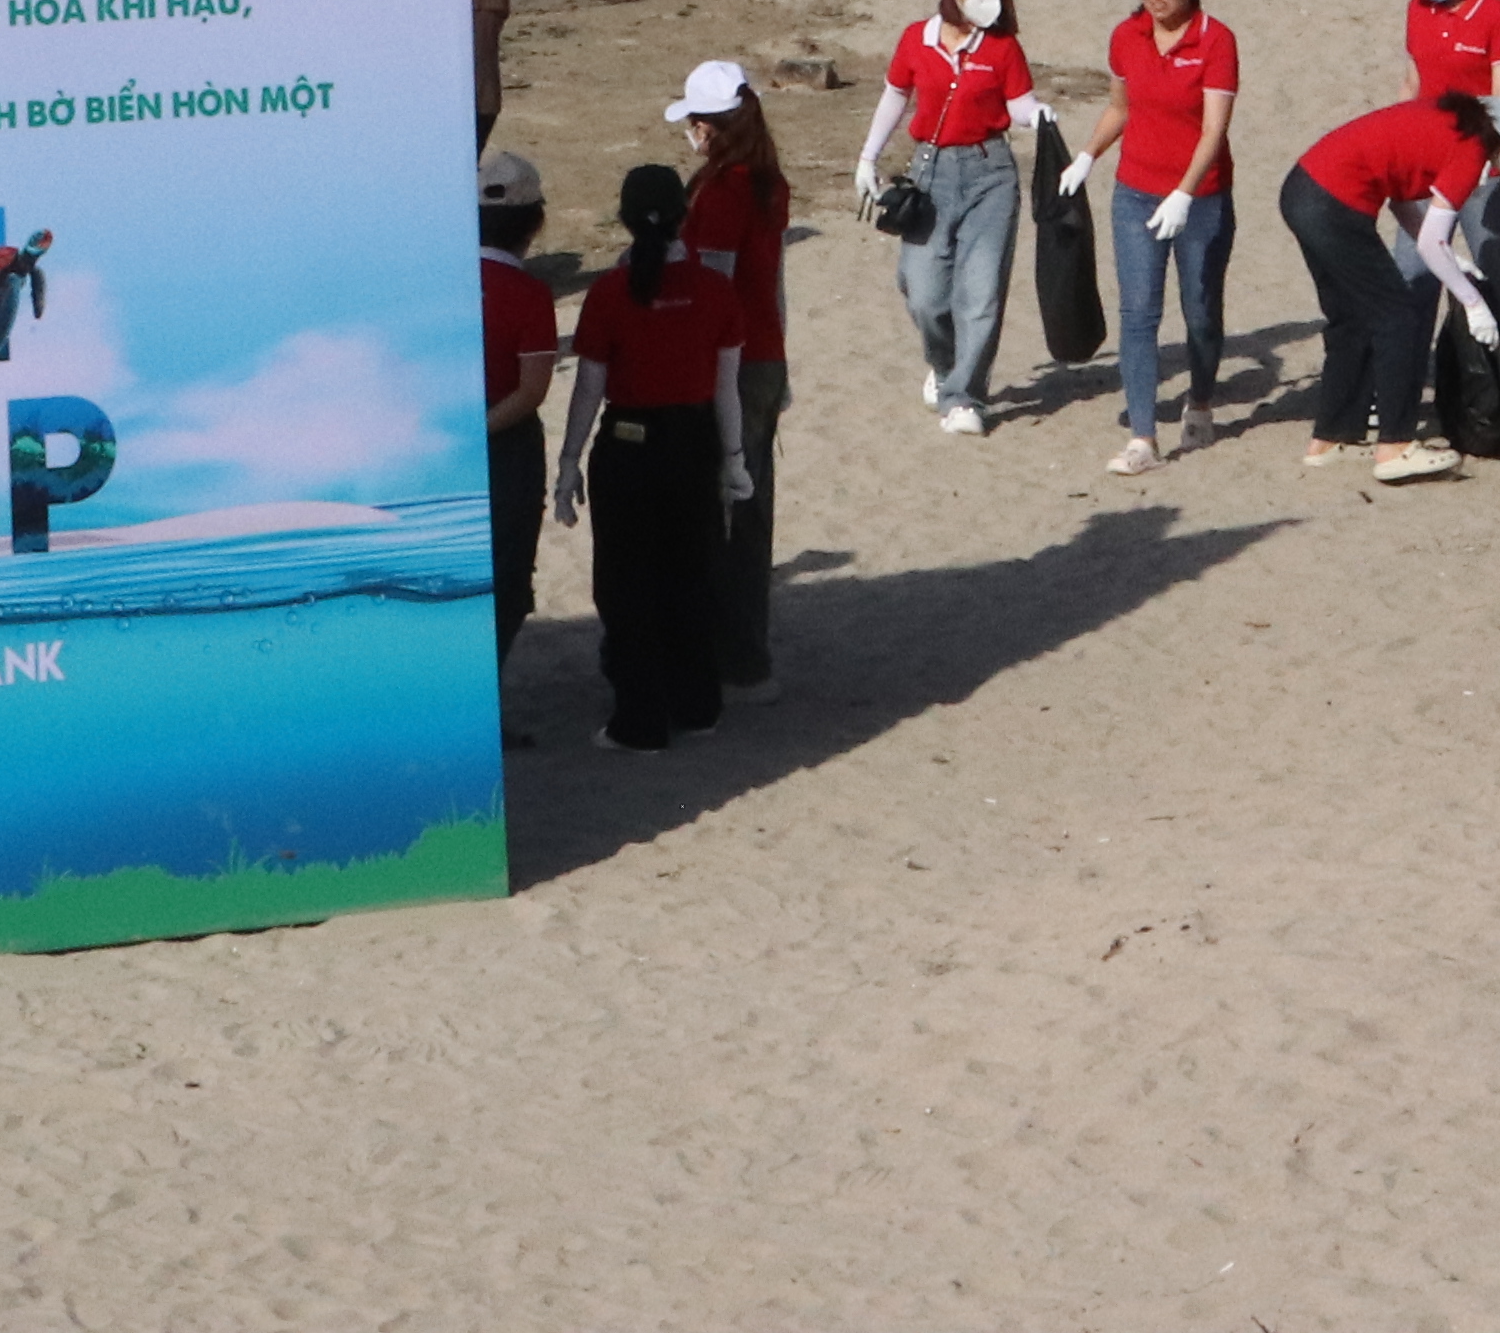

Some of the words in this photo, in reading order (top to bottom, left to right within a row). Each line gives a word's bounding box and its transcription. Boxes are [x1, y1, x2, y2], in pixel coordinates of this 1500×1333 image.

[26, 90, 76, 128] BỜ
[85, 78, 163, 124] BIỂN
[172, 80, 250, 118] HÒN
[259, 74, 334, 119] MỘT
